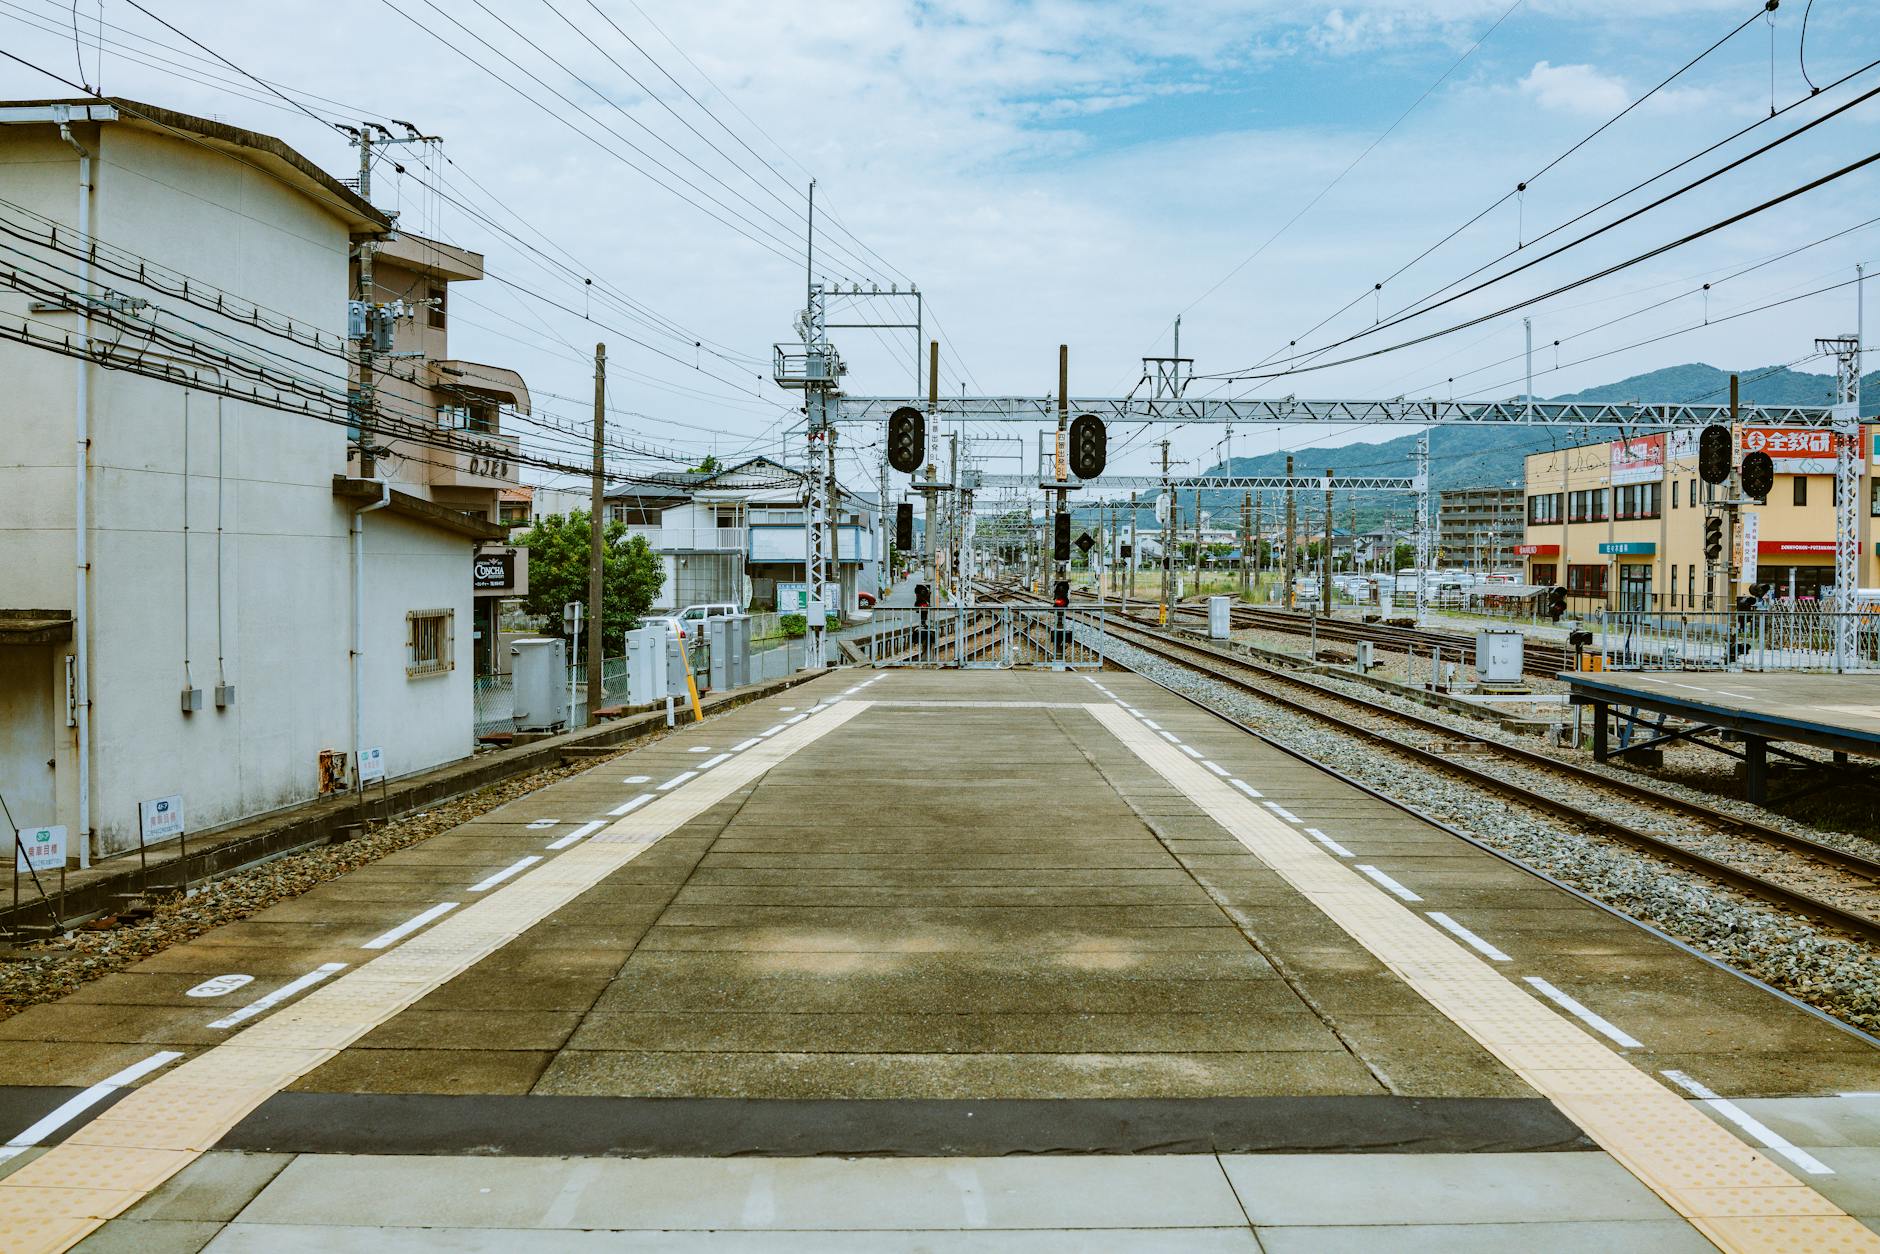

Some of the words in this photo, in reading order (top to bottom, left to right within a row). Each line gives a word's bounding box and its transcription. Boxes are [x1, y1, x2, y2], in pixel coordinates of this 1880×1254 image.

[1767, 431, 1830, 452] 全教研
[474, 564, 505, 580] CONCHA
